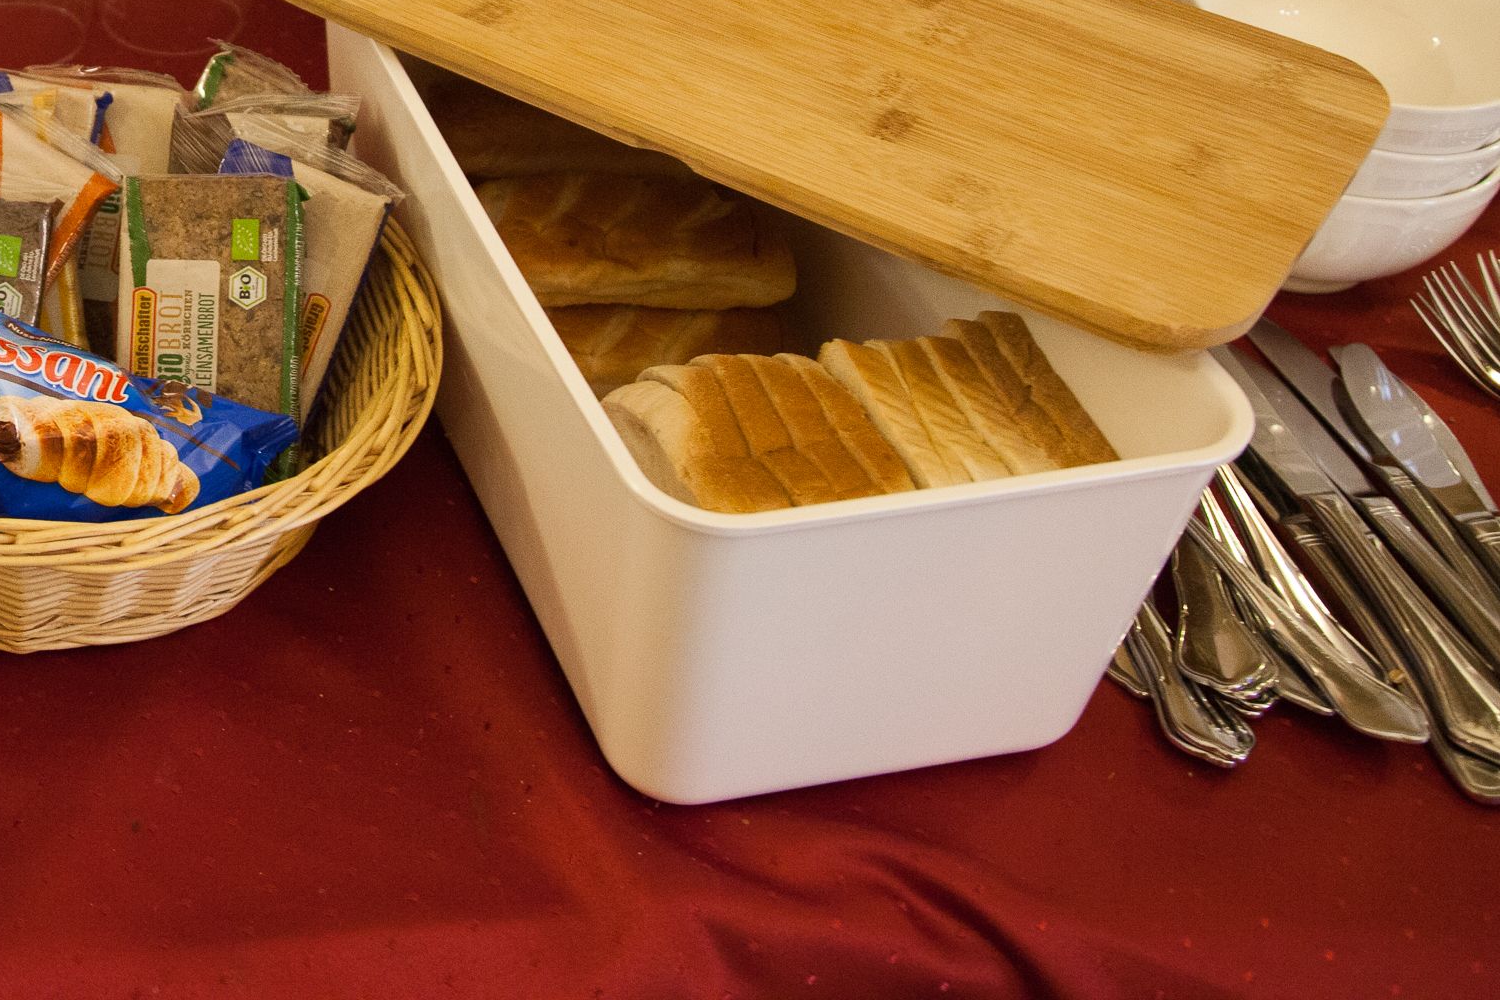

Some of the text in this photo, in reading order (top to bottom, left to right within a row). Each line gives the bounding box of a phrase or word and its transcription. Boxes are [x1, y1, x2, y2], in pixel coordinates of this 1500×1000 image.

[157, 290, 183, 350] BROT
[182, 289, 194, 350] KÖRBCHEN
[196, 292, 215, 387] LEINSAMENBROT
